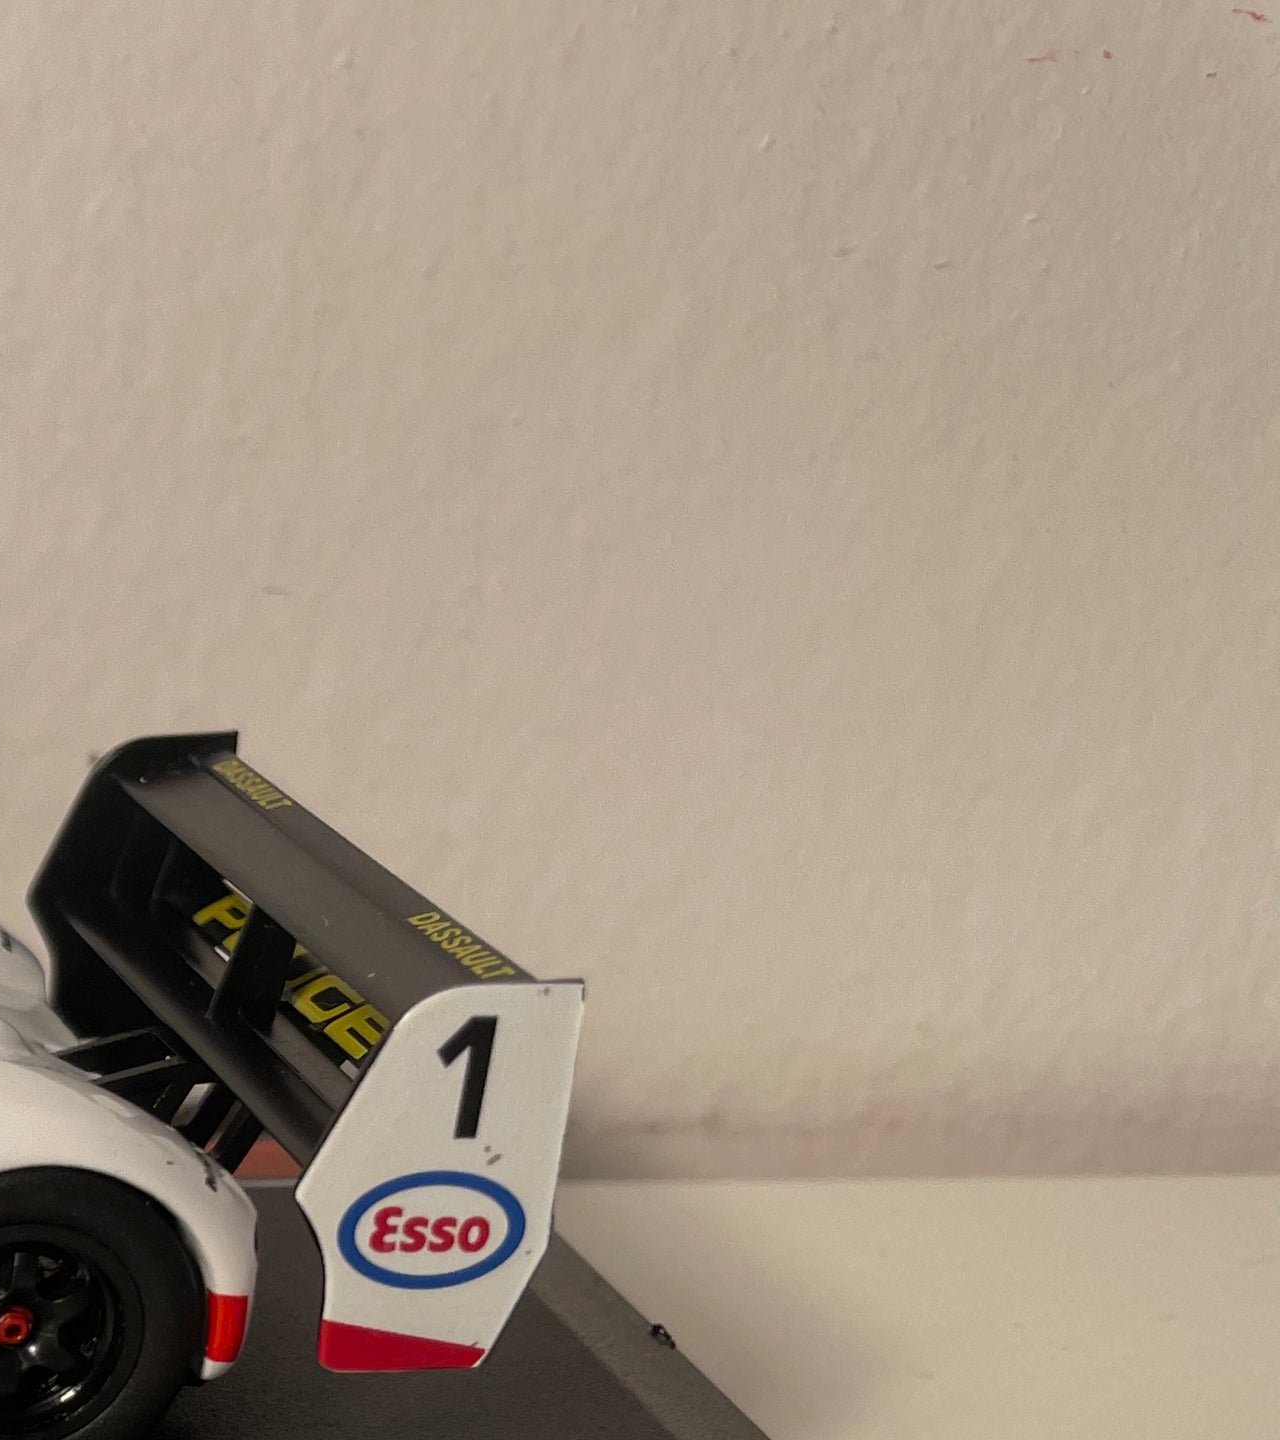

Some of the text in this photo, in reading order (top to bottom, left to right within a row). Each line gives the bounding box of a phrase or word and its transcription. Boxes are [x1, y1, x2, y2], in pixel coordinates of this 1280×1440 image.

[212, 757, 293, 810] DASSAULT
[406, 911, 516, 980] DASSAULT
[436, 1014, 499, 1140] 1
[366, 1205, 491, 1254] Esso
